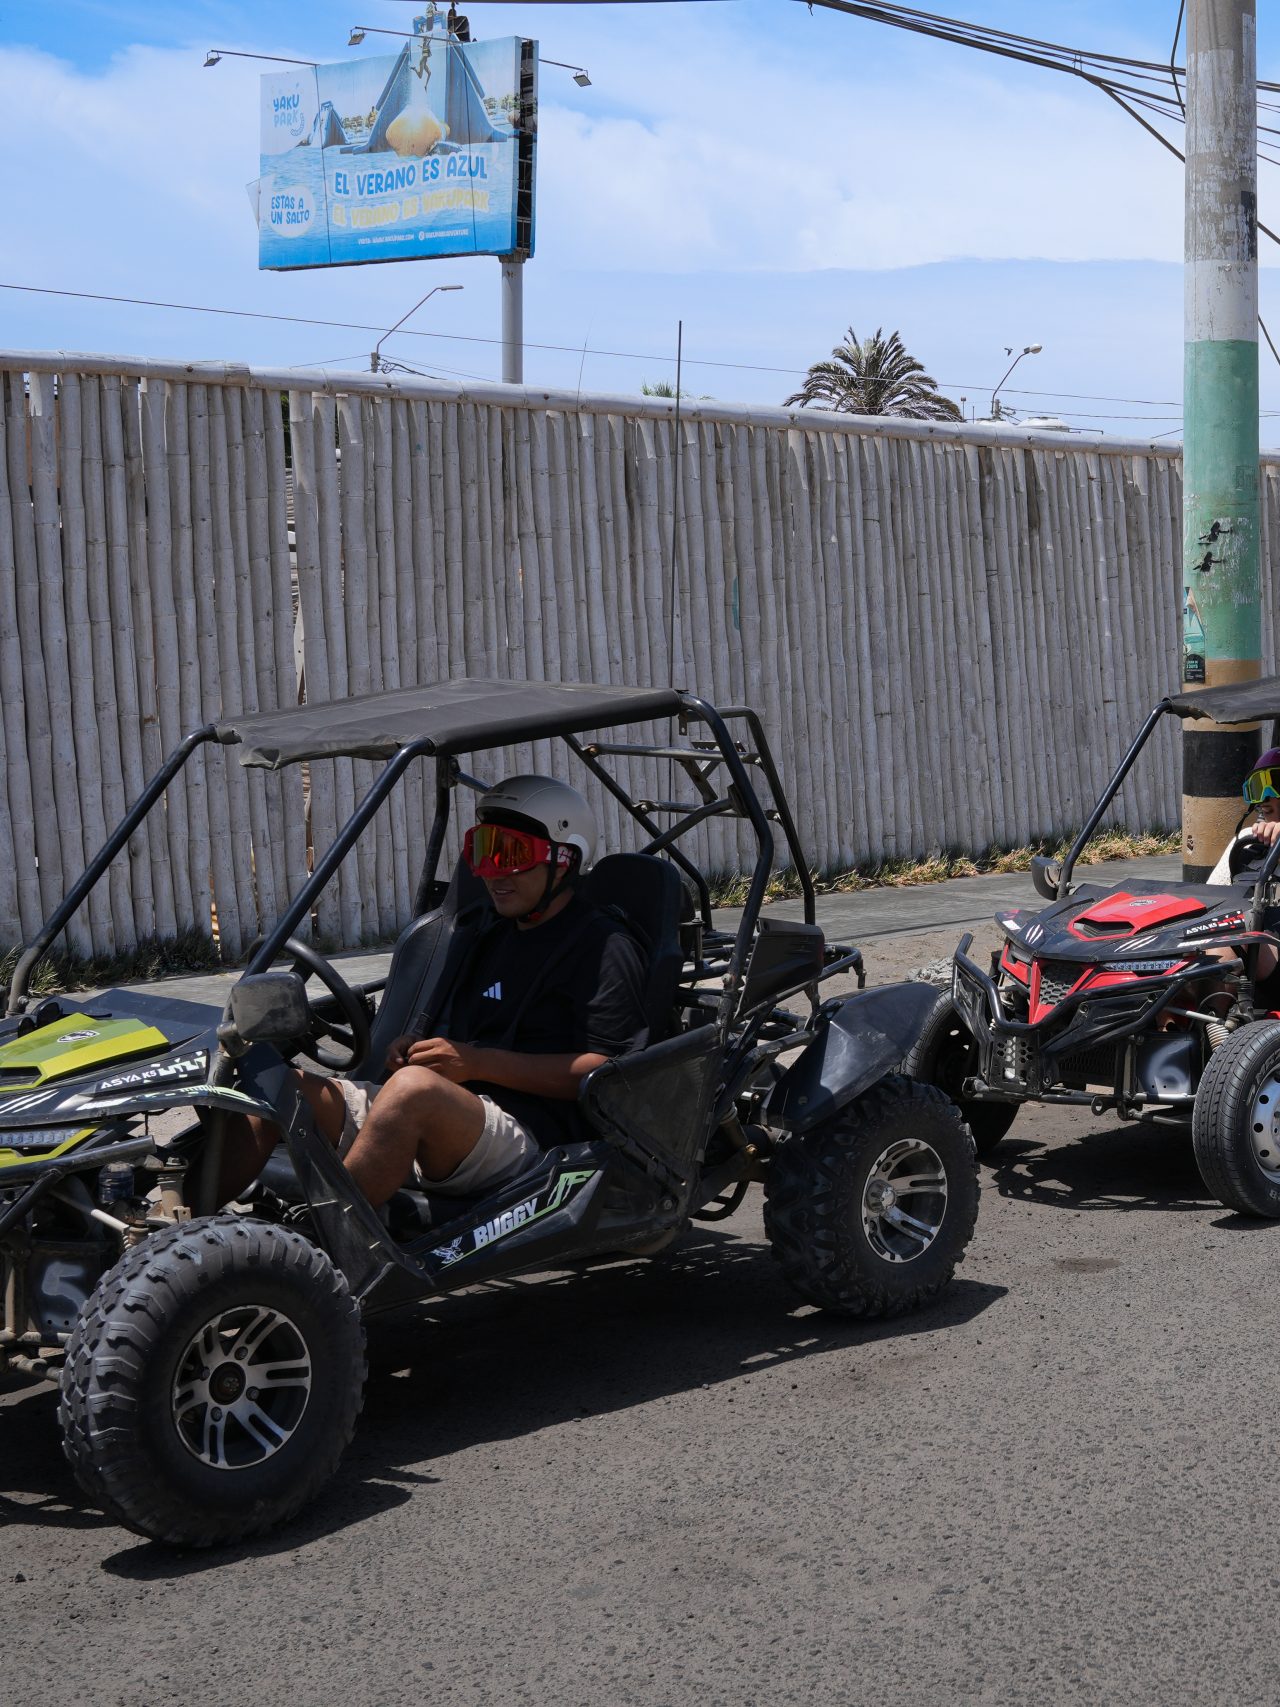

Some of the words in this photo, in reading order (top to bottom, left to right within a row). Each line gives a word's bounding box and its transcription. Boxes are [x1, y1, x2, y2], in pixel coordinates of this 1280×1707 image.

[273, 94, 300, 112] YAKU
[273, 110, 299, 128] PARK
[334, 171, 350, 195] EL
[356, 164, 416, 196] VERANO
[422, 157, 441, 182] ES
[446, 154, 488, 180] AZUL
[271, 194, 295, 209] ESTAS
[298, 197, 304, 209] A
[271, 210, 283, 224] UN
[286, 209, 310, 224] SALTO
[1186, 924, 1209, 935] ASYA
[1146, 1037, 1193, 1095] 6
[101, 1074, 142, 1089] ASYA
[142, 1070, 157, 1080] K5
[473, 1198, 538, 1249] BUGGY
[42, 1262, 88, 1330] 5
